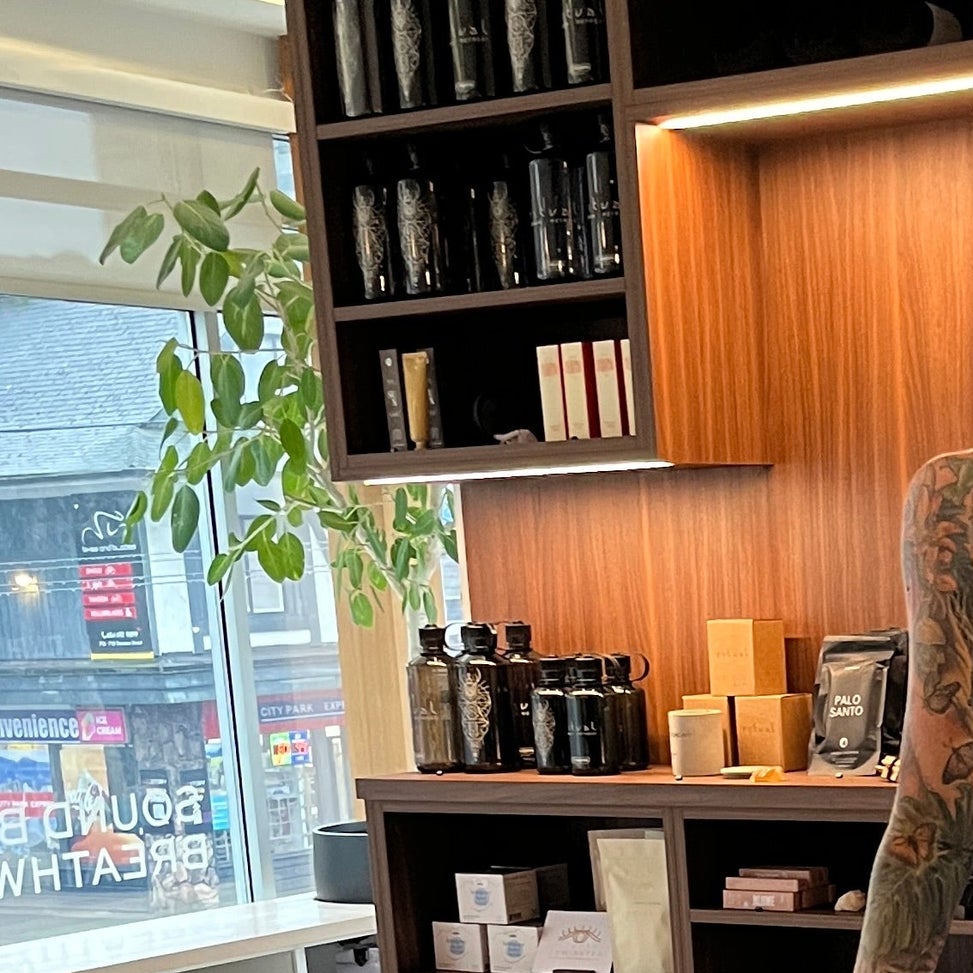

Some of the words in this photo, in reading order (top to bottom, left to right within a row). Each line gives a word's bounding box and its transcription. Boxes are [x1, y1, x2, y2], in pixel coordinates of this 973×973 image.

[834, 694, 861, 706] PALO
[260, 706, 284, 717] CITY
[285, 703, 314, 714] PARK
[829, 706, 864, 718] SANTO
[96, 726, 122, 736] CREAM
